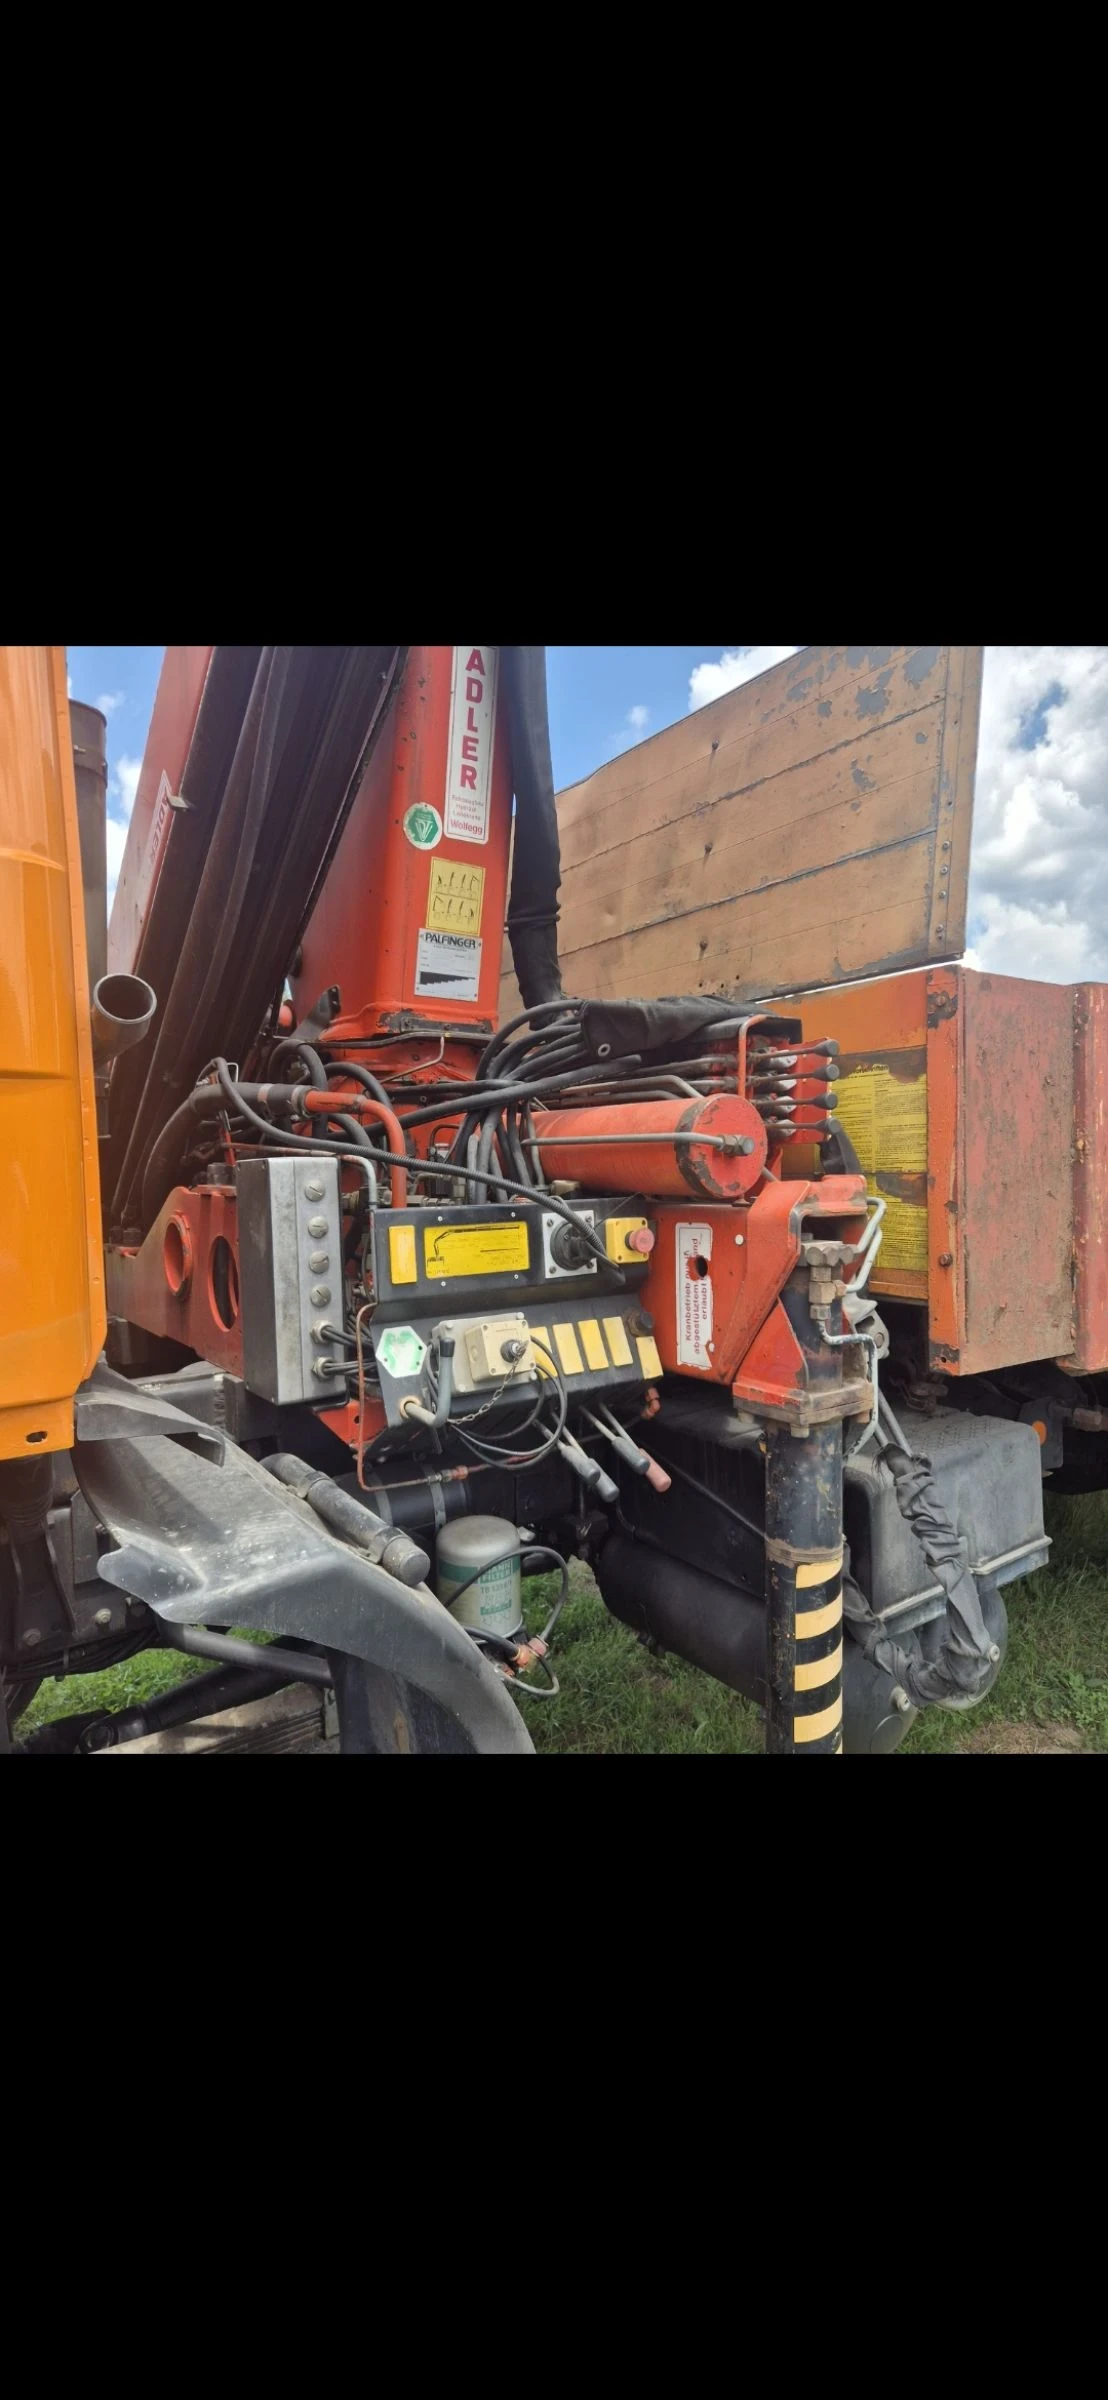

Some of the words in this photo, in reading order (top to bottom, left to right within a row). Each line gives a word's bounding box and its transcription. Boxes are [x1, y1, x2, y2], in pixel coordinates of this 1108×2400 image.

[460, 648, 486, 790] ADLER
[450, 820, 483, 835] Wolfegg
[425, 932, 476, 948] PALFINGER
